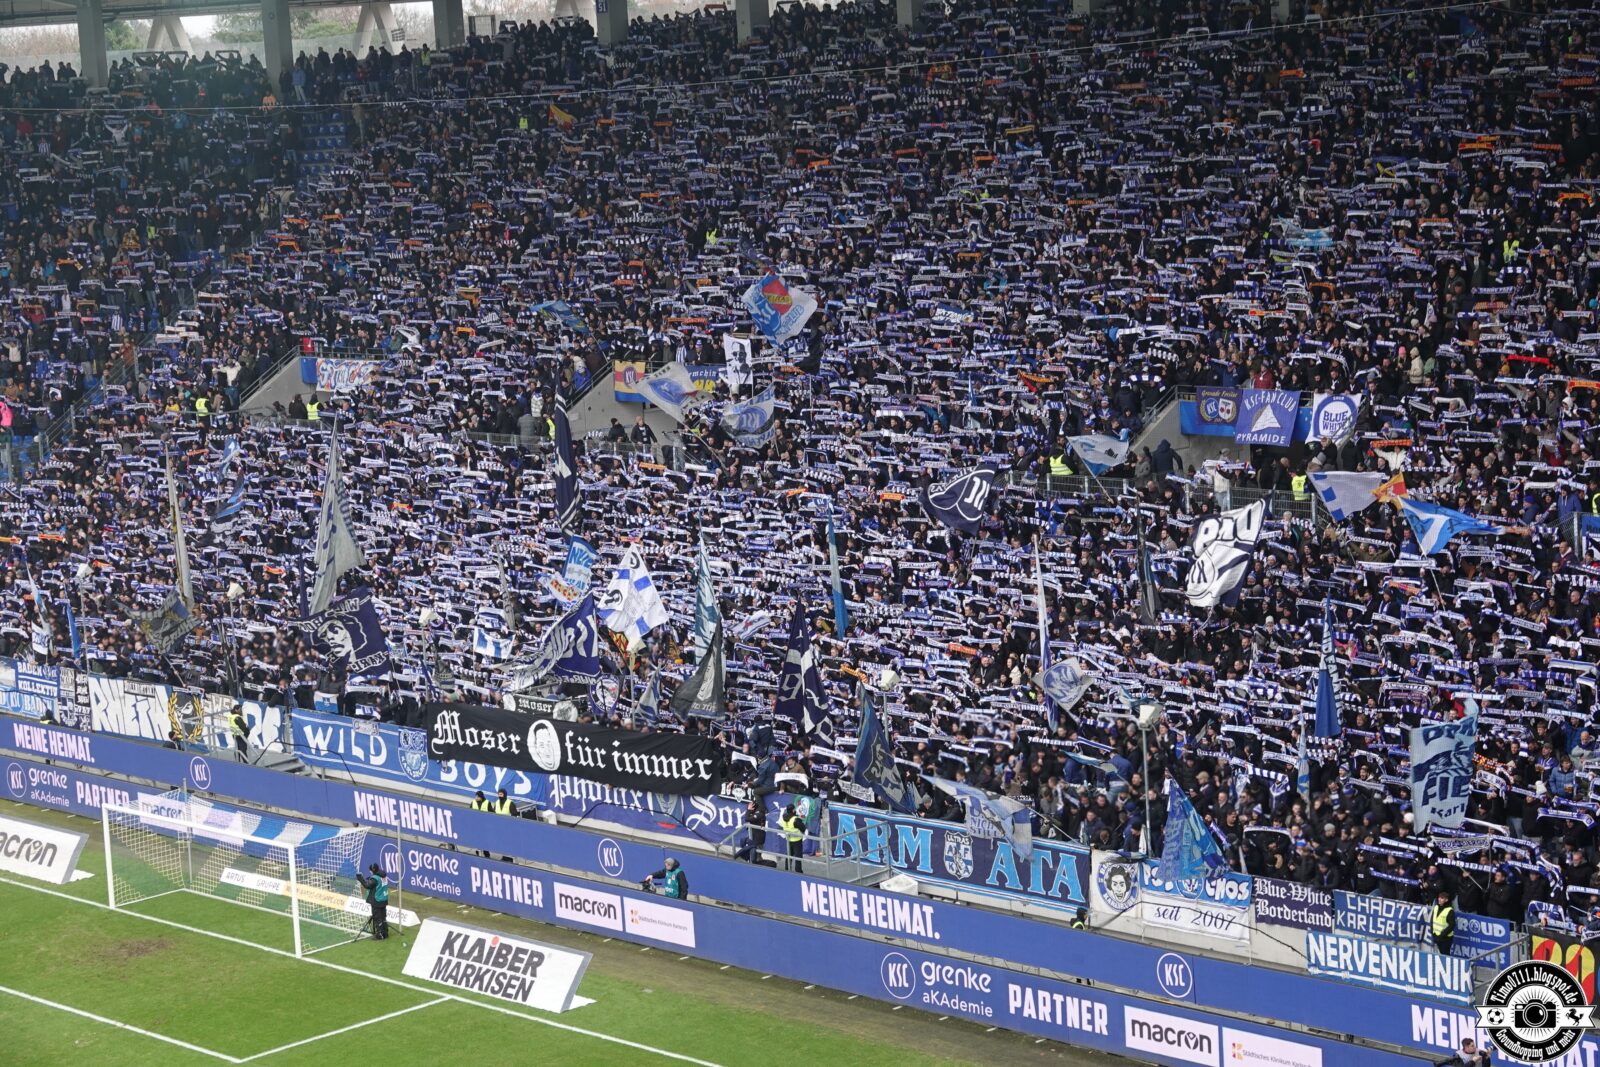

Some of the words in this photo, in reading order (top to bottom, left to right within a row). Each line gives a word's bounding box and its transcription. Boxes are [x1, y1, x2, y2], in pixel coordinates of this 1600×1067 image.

[1323, 410, 1349, 422] BLUE
[1236, 433, 1286, 444] PYRAMIDE
[13, 723, 48, 753] MEINE
[47, 729, 95, 763] HEIMAT.
[303, 724, 388, 766] WILD
[431, 709, 521, 755] Moser
[565, 730, 607, 769] für
[612, 740, 713, 781] immer
[10, 770, 24, 790] KSC
[28, 767, 69, 789] grenke
[194, 763, 208, 782] KSC
[30, 789, 70, 807] aKAdemie
[76, 781, 130, 808] PARTNER
[353, 791, 397, 826] MEINE
[399, 800, 459, 840] HEIMAT.
[946, 833, 971, 845] ULTRAS
[384, 851, 400, 874] KSC
[408, 849, 460, 876] grenke
[602, 847, 620, 868] KSC
[225, 871, 247, 883] ARTUS
[256, 878, 282, 891] GRUPPE
[410, 875, 462, 897] aKAdemie
[470, 866, 545, 908] PARTNER
[1253, 877, 1332, 907] Blue-White
[349, 901, 371, 913] ARTUS
[558, 892, 618, 920] macron
[800, 880, 860, 923] MEINE
[861, 892, 941, 940] HEIMAT.
[1154, 904, 1181, 922] seit
[1191, 909, 1238, 932] 2007
[1254, 899, 1333, 928] Borderland
[888, 962, 909, 988] KSC
[1164, 963, 1185, 987] KSC
[1308, 932, 1474, 994] NERVENKLINIK
[429, 956, 535, 1003] MARKISEN
[920, 960, 992, 994] grenke
[922, 990, 993, 1018] aKAdemie
[1008, 983, 1109, 1036] PARTNER
[1131, 1018, 1212, 1055] macron
[1242, 1049, 1270, 1062] Städtisches
[1270, 1056, 1292, 1066] Klinikum
